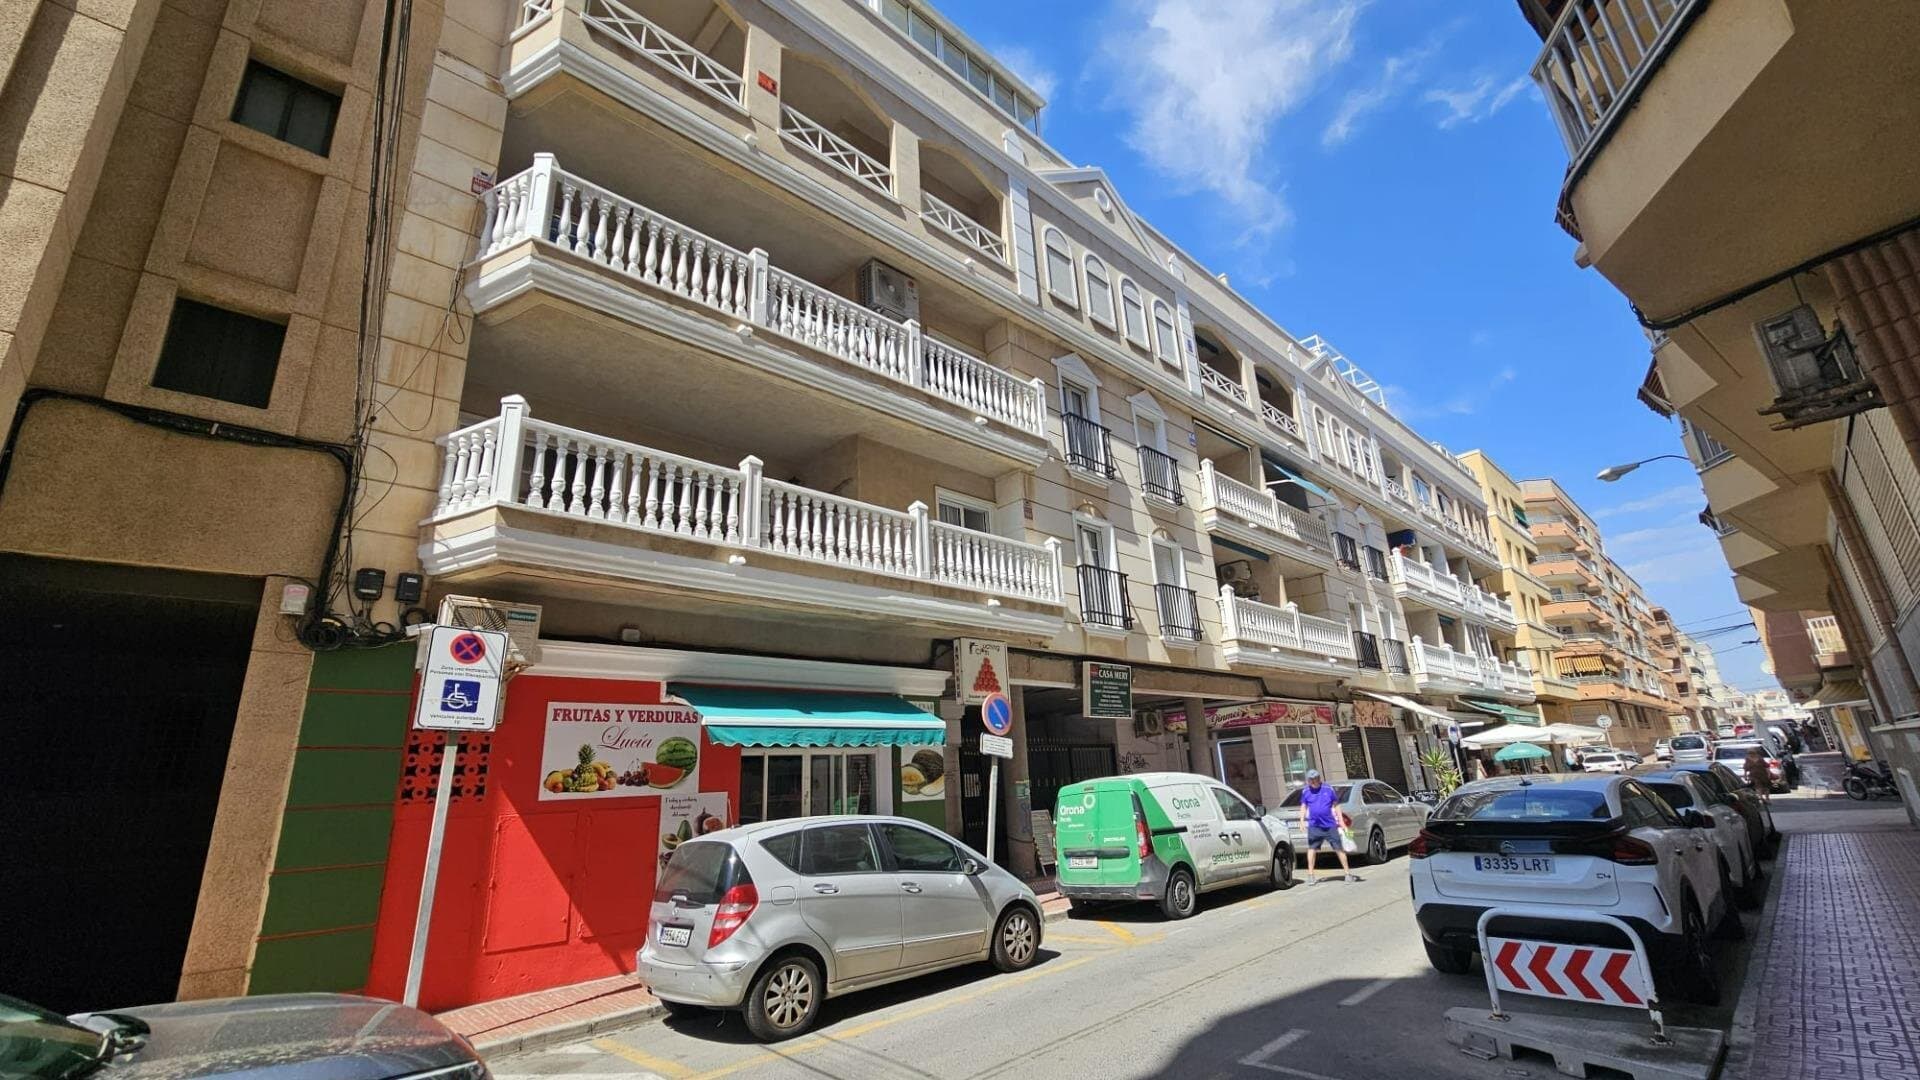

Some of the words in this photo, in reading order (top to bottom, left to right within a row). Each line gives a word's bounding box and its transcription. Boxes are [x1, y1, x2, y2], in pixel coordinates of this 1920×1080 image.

[1098, 669, 1114, 679] CASA
[552, 708, 610, 722] FRUTAS
[615, 709, 625, 723] Y
[628, 710, 699, 724] VERDURAS
[597, 725, 653, 750] Lucía
[1060, 805, 1085, 816] Orona
[1172, 797, 1201, 810] Orona
[1212, 850, 1234, 865] getting
[1483, 857, 1519, 870] 3335
[1522, 858, 1550, 872] LRT
